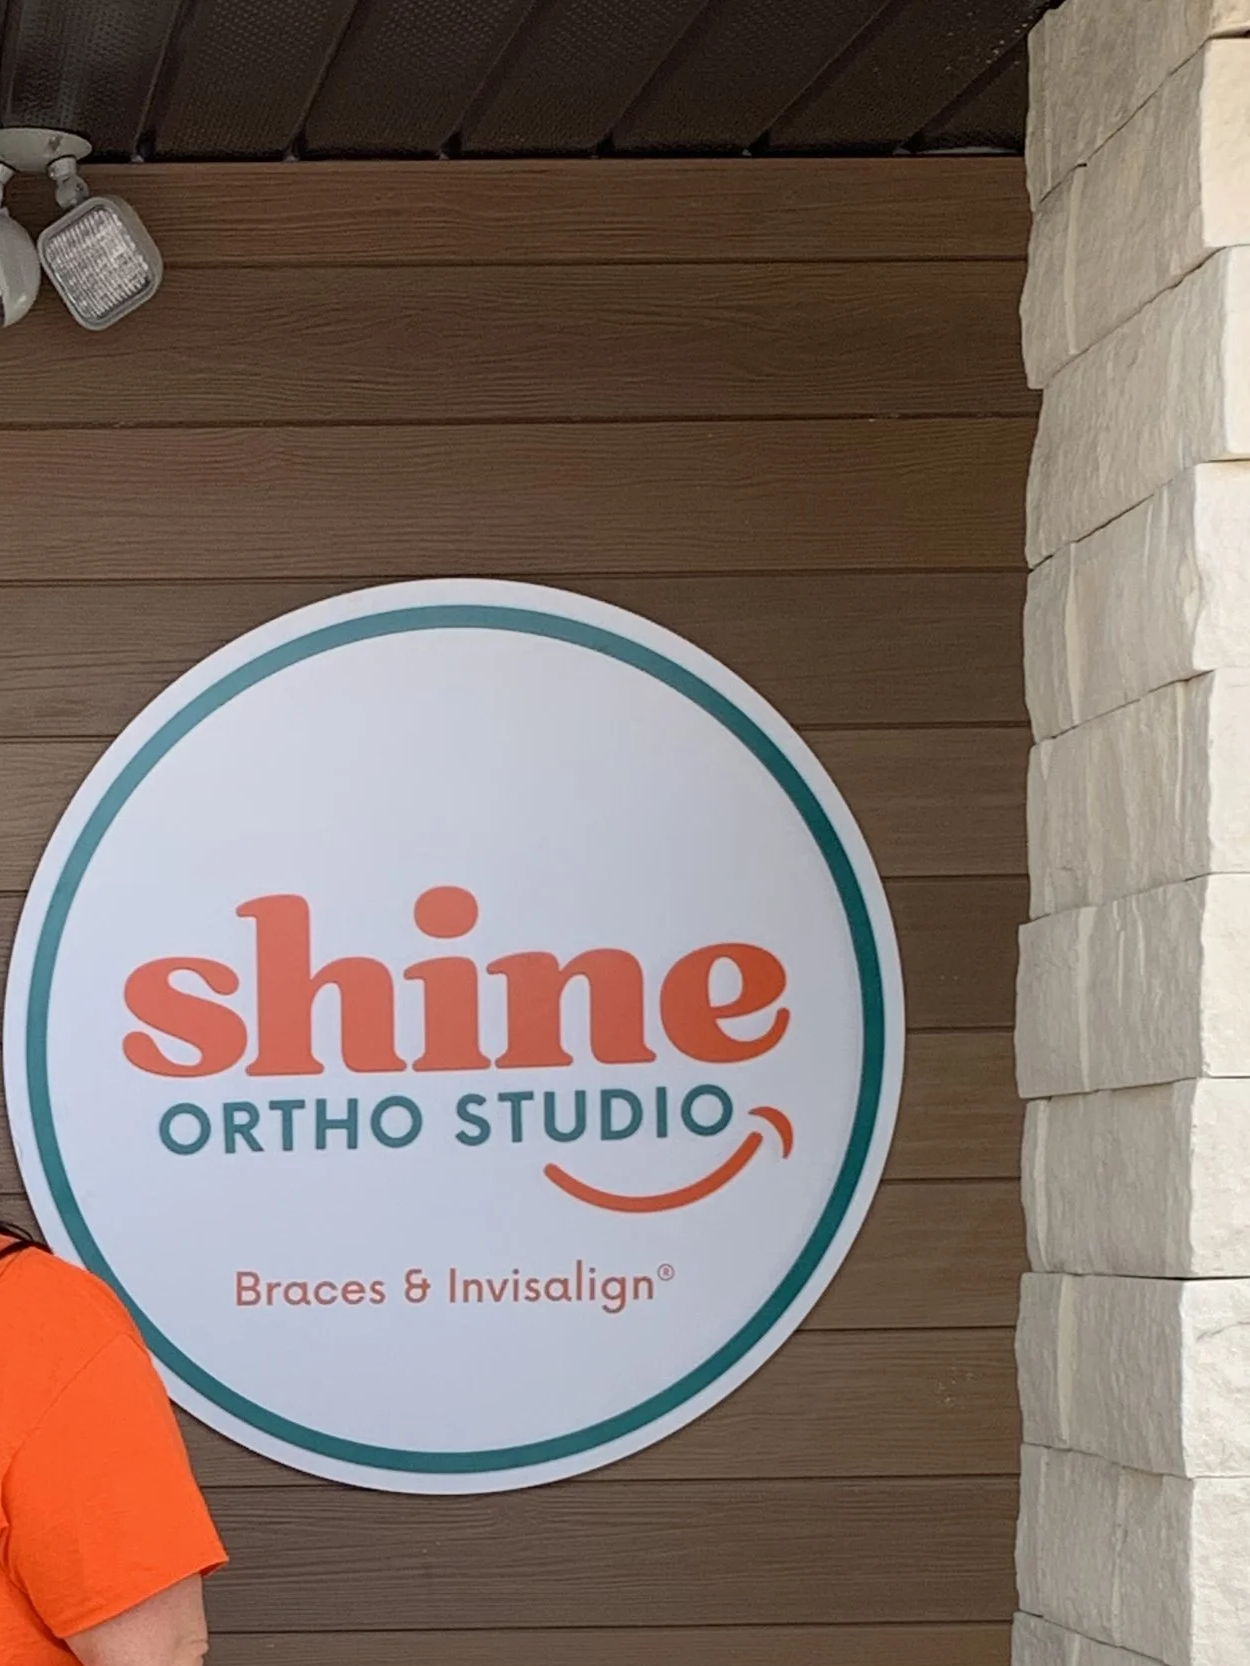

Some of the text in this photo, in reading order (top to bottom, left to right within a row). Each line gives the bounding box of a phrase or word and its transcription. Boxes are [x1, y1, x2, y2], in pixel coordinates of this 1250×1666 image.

[122, 885, 791, 1079] shine
[158, 1084, 734, 1155] ORTHO STUDIO
[235, 1268, 387, 1307] Braces
[404, 1267, 431, 1305] &
